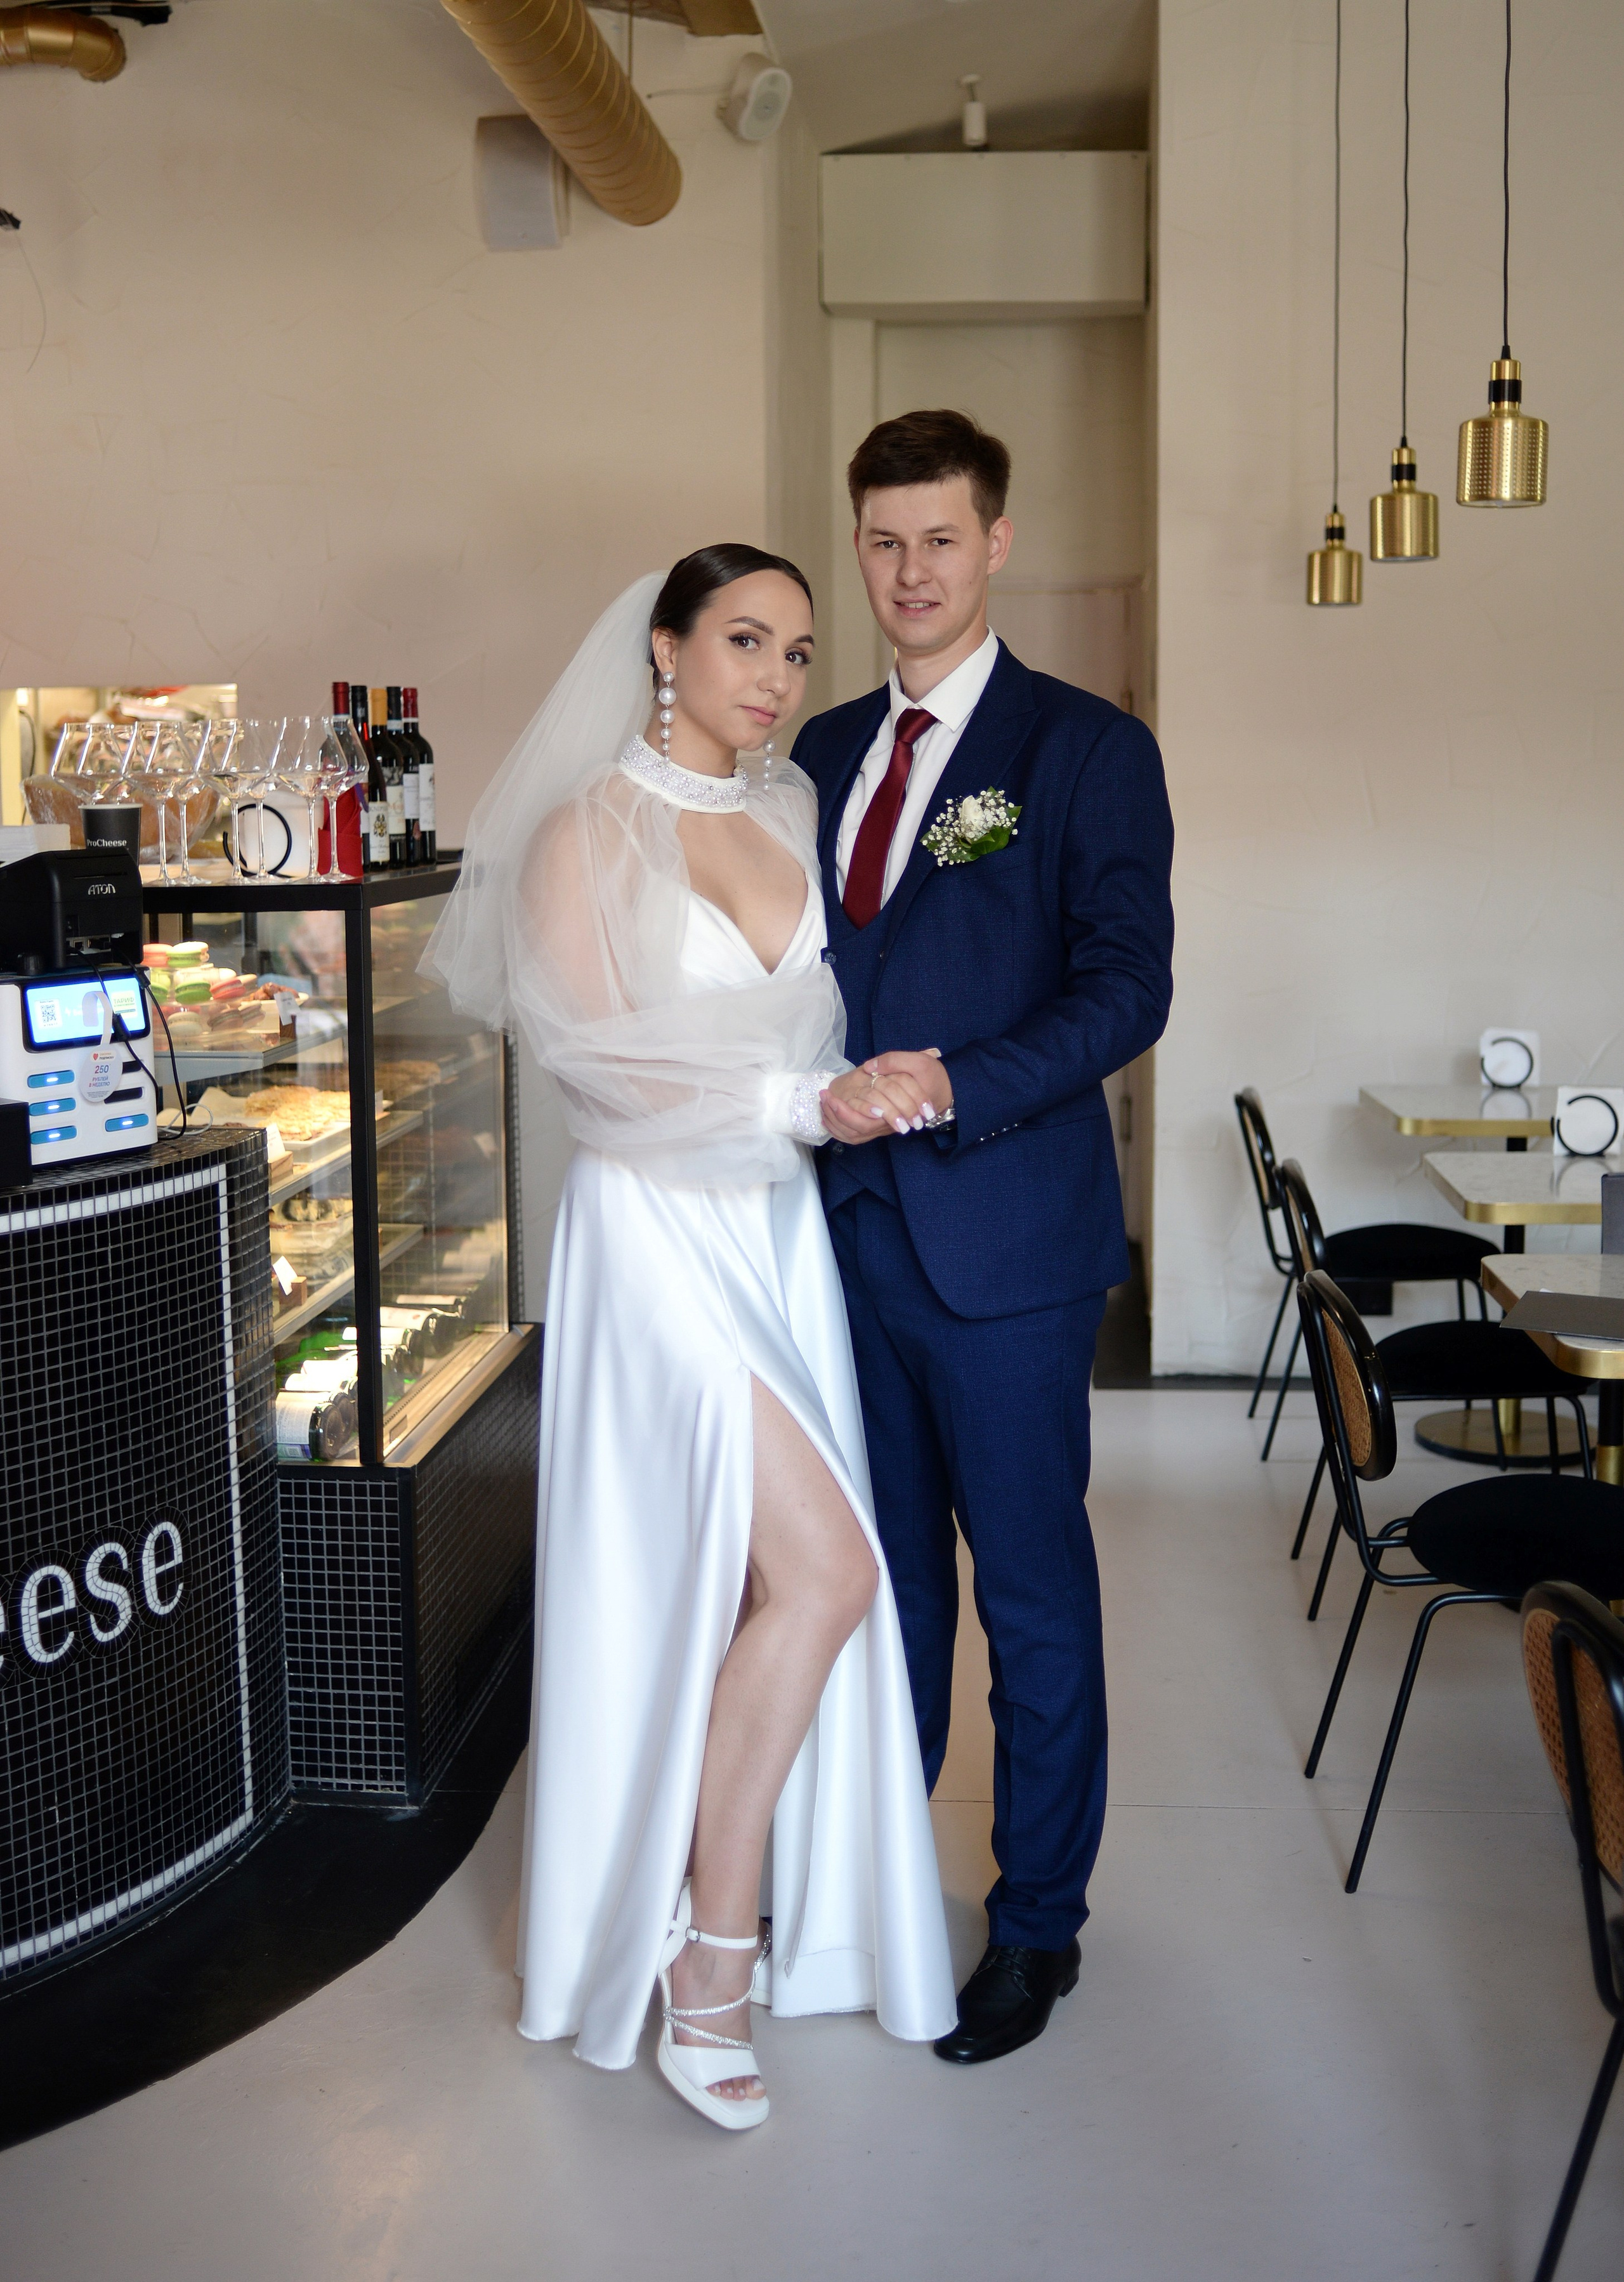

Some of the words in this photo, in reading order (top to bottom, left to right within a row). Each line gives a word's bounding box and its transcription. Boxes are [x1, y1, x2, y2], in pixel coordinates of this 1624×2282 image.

[87, 839, 127, 847] ProCheese
[95, 1065, 109, 1074] 250
[0, 1522, 184, 1670] ese
